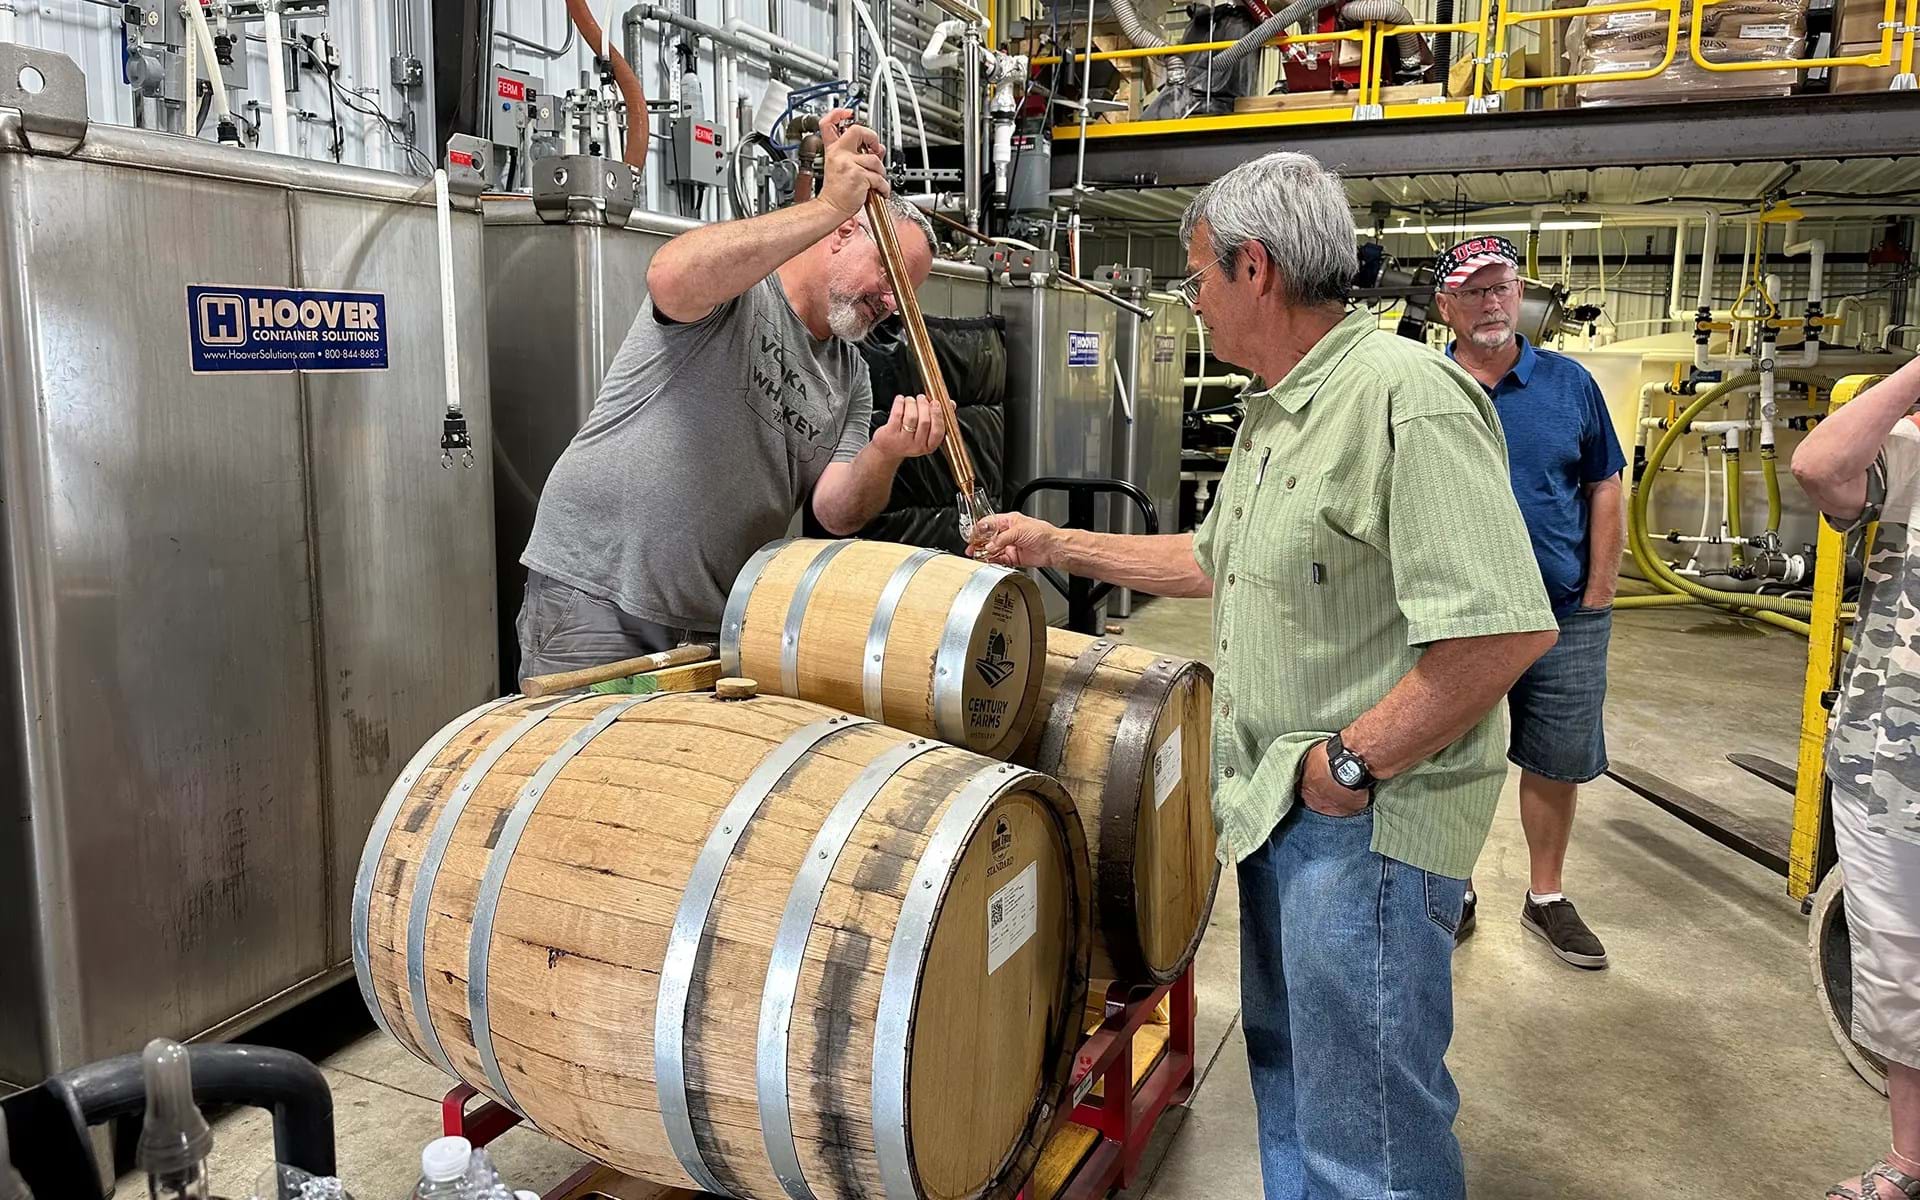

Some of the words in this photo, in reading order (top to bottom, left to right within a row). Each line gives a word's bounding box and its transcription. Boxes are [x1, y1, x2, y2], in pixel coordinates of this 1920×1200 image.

[1700, 40, 1727, 49] RIESS
[498, 80, 518, 95] FERM
[1452, 237, 1501, 262] USA
[249, 298, 379, 329] HOOVER
[252, 329, 319, 342] CONTAINER
[322, 330, 380, 342] SOLUTIONS
[203, 349, 315, 360] www.HooverSolutions.com
[324, 348, 380, 359] 800-844-8683
[968, 697, 1009, 715] CENTURY
[970, 713, 1001, 729] FARMS
[986, 856, 1015, 878] STANDARD
